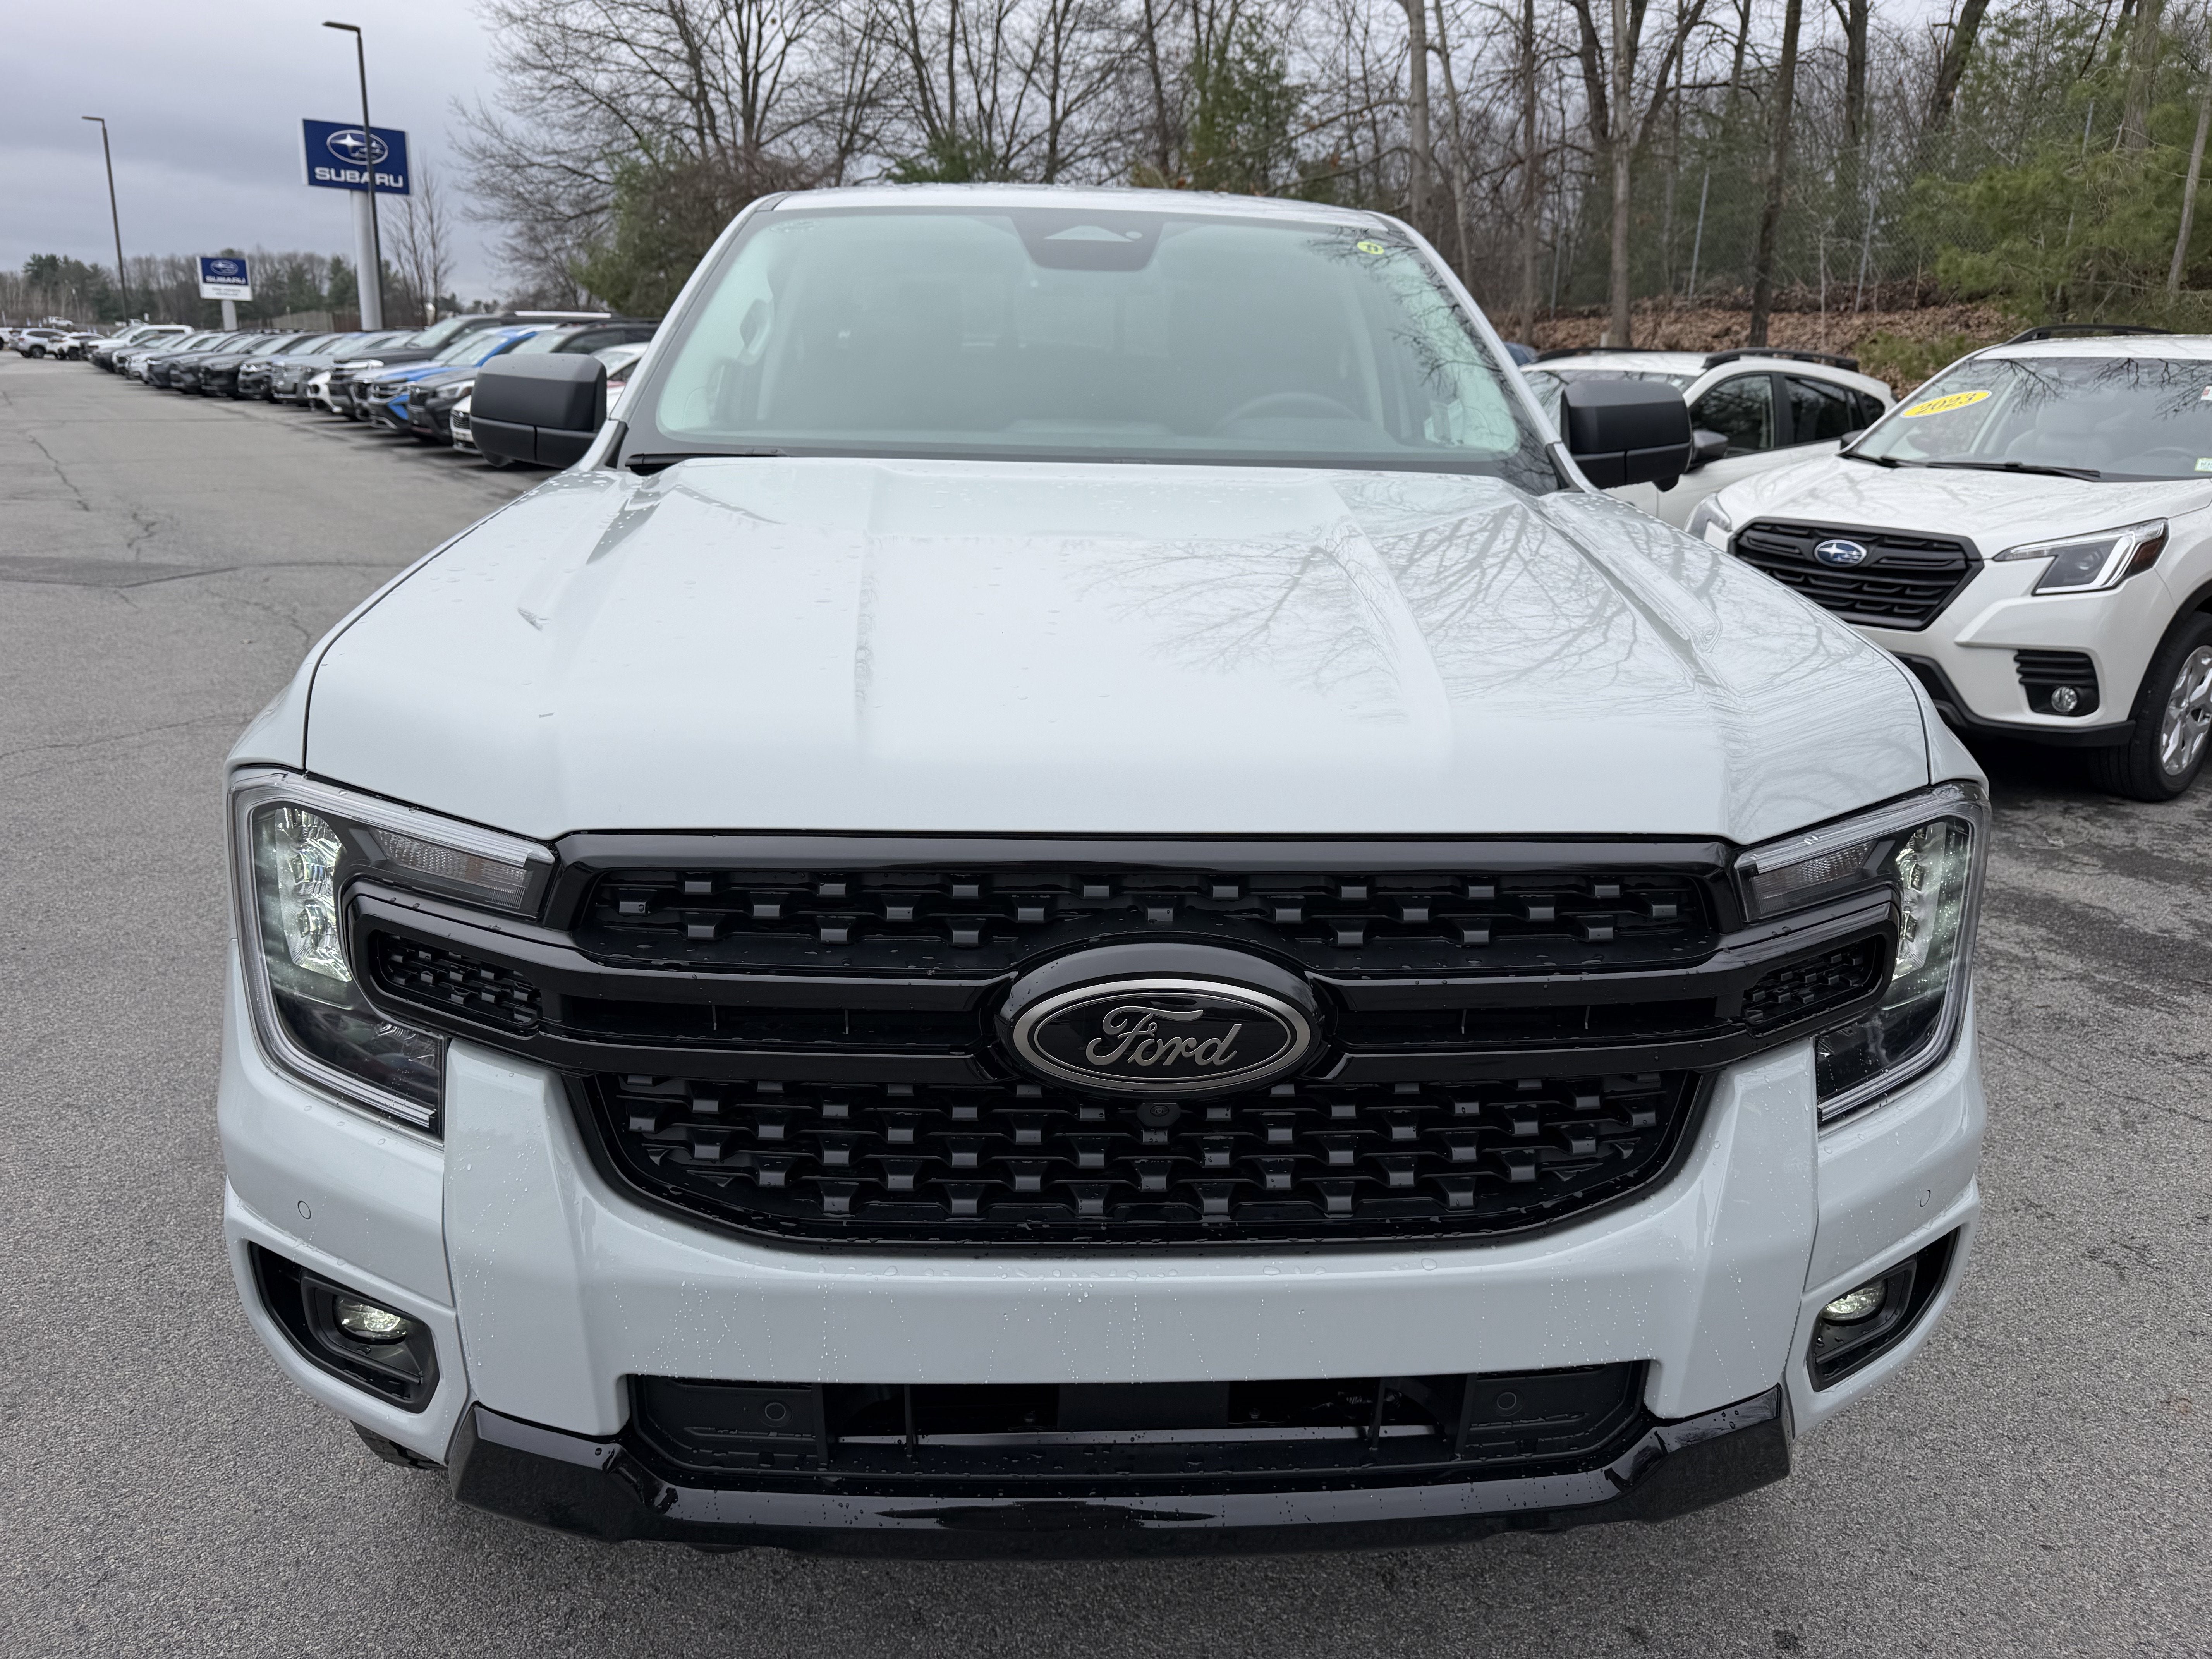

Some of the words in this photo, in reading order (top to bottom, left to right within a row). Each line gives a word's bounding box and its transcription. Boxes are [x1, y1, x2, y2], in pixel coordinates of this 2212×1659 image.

[314, 167, 404, 188] SUBARU
[205, 275, 246, 284] SUBARU
[1915, 393, 1977, 415] 2023
[1085, 1006, 1242, 1066] Ford
